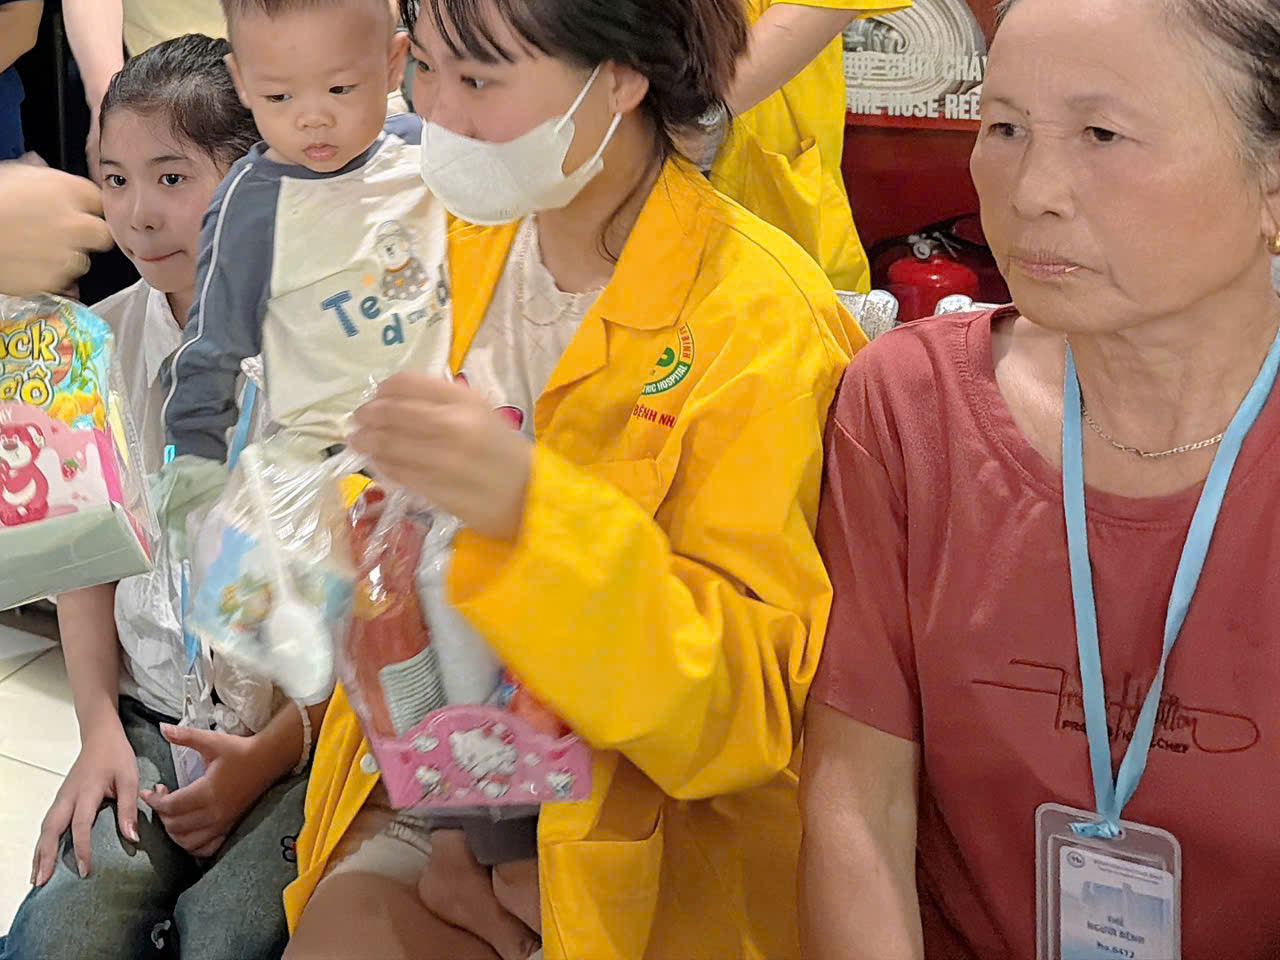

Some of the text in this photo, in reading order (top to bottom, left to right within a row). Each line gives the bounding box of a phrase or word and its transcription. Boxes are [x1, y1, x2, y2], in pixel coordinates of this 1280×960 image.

[887, 94, 939, 118] HOSE
[945, 94, 981, 120] REE
[657, 365, 688, 391] HOSPITAL
[658, 414, 676, 428] NH
